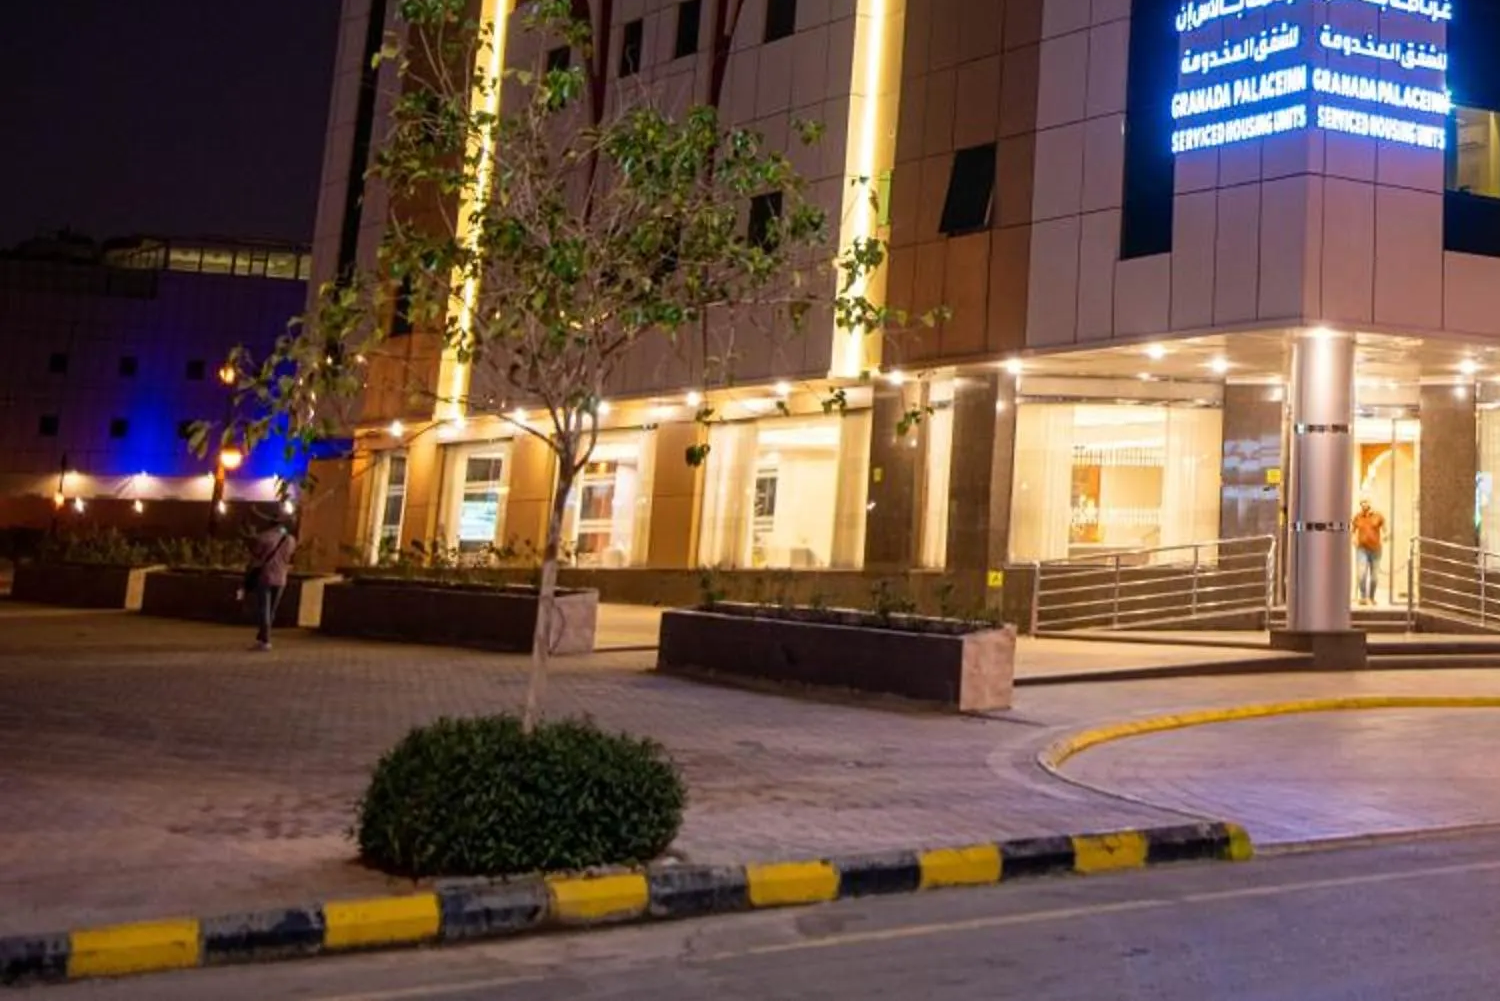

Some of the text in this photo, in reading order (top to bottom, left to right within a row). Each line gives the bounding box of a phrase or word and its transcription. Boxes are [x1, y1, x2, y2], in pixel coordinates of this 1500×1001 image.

[1171, 82, 1231, 119] GRANADA
[1312, 67, 1377, 103] GRANADA
[1171, 122, 1225, 154] SERVICED
